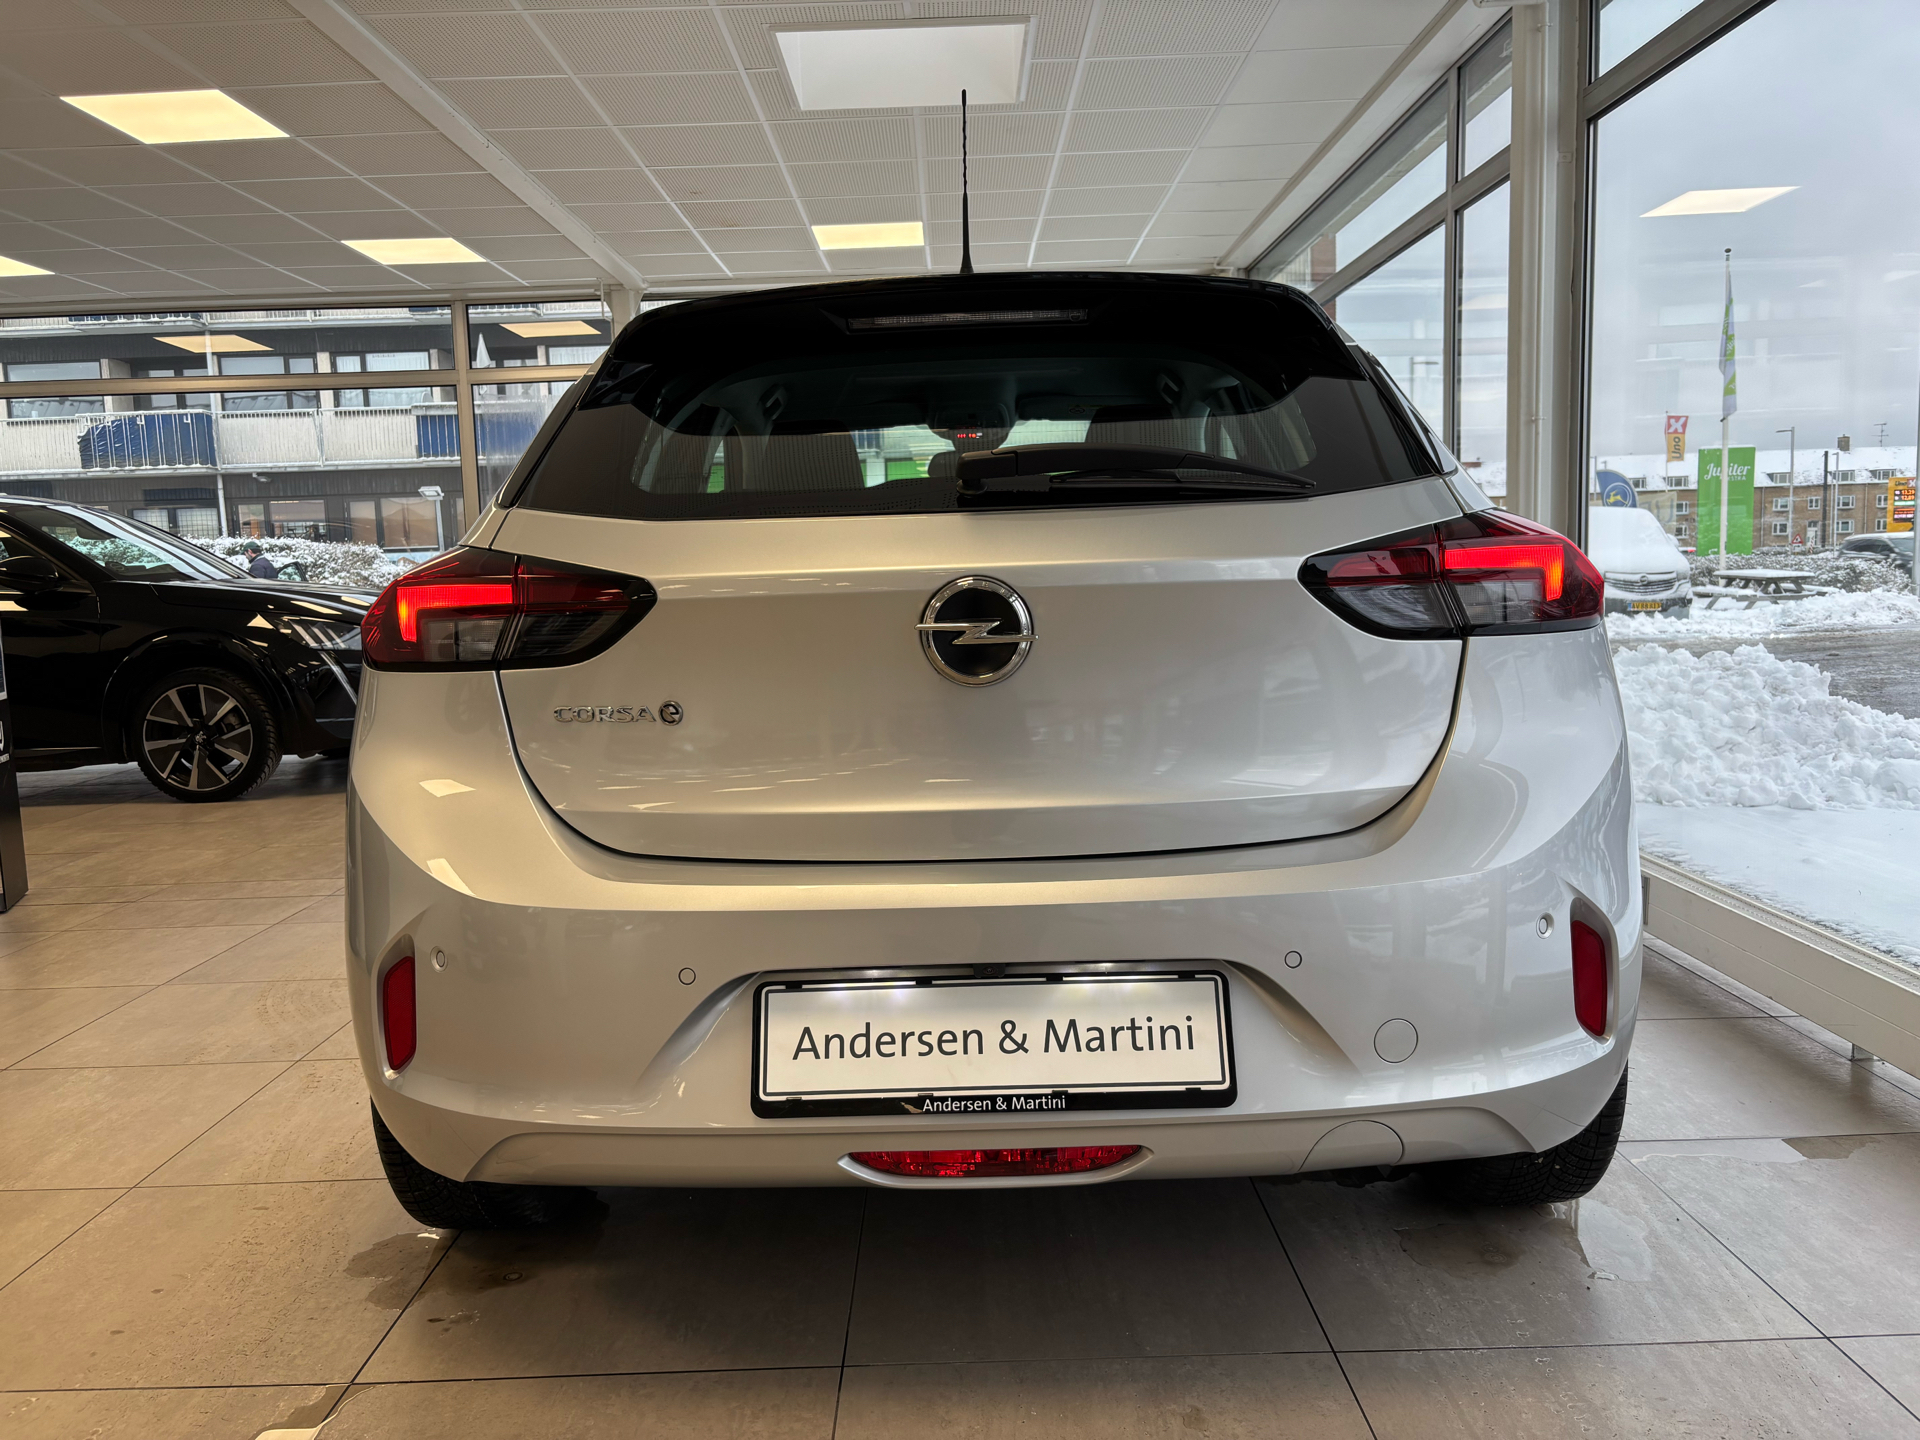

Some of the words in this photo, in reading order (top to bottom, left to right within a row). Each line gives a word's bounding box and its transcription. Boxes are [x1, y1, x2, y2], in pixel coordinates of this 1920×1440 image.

[1671, 436, 1683, 459] Uno
[1704, 463, 1751, 480] Juiter
[553, 706, 657, 723] CORSA
[792, 1022, 985, 1060] Andersen
[999, 1019, 1029, 1054] &
[1043, 1015, 1195, 1053] Martini
[922, 1097, 991, 1112] Andersen
[996, 1096, 1007, 1110] &
[1012, 1095, 1066, 1110] Martini
